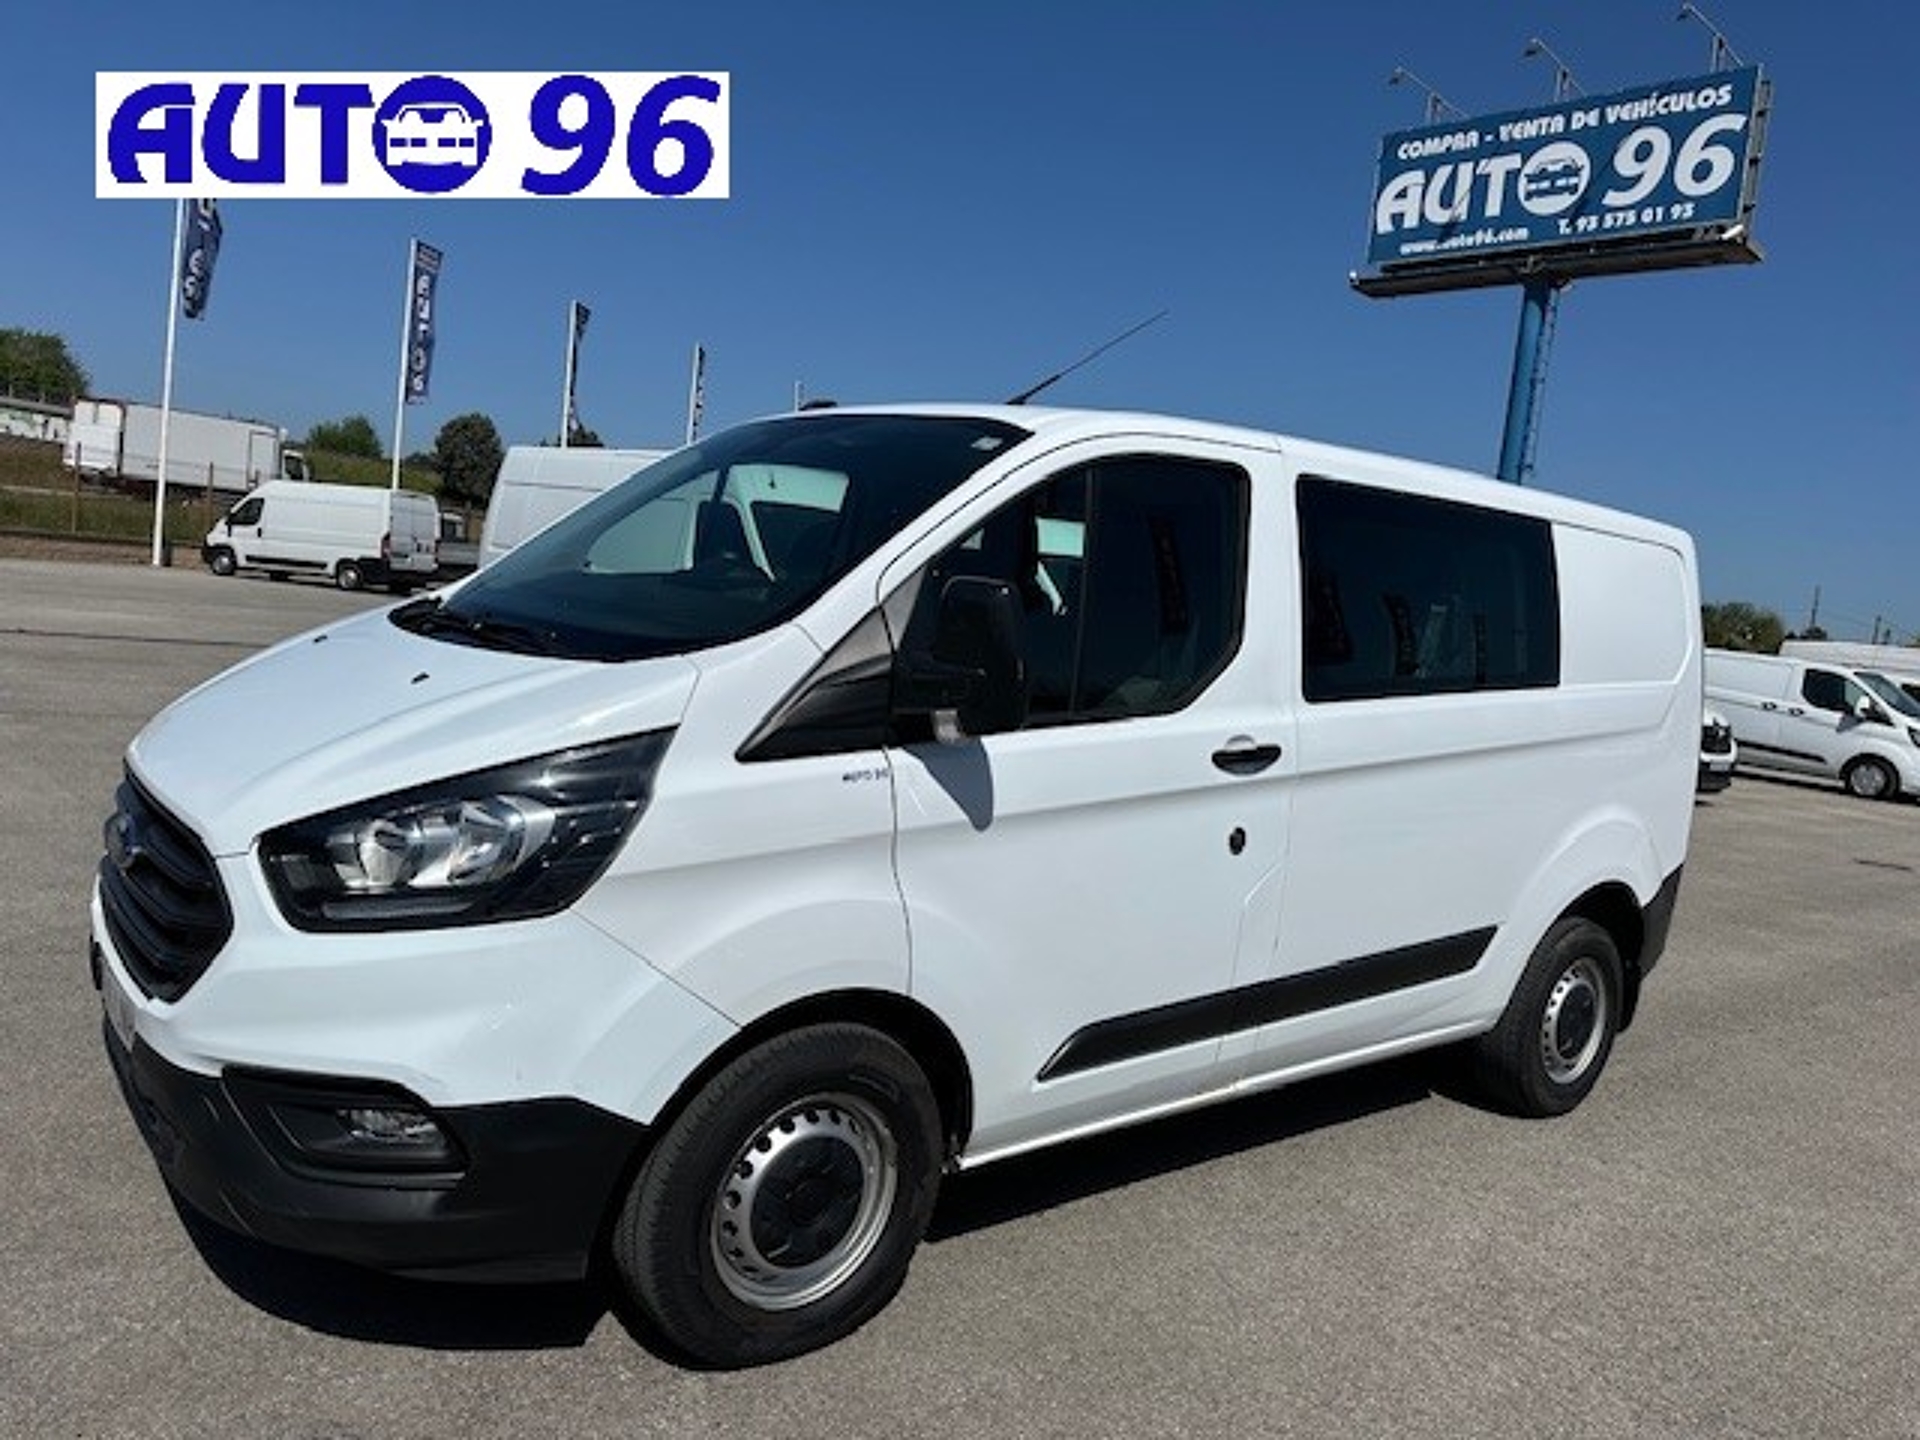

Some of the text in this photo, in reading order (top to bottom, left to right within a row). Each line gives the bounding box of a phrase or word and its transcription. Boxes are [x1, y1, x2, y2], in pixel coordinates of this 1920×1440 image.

[1397, 129, 1480, 160] COMPRA
[1499, 113, 1566, 142] VENTA
[1571, 107, 1601, 131] DE
[1604, 83, 1733, 124] VEHÍCULOS
[1376, 113, 1748, 234] AUTO 96
